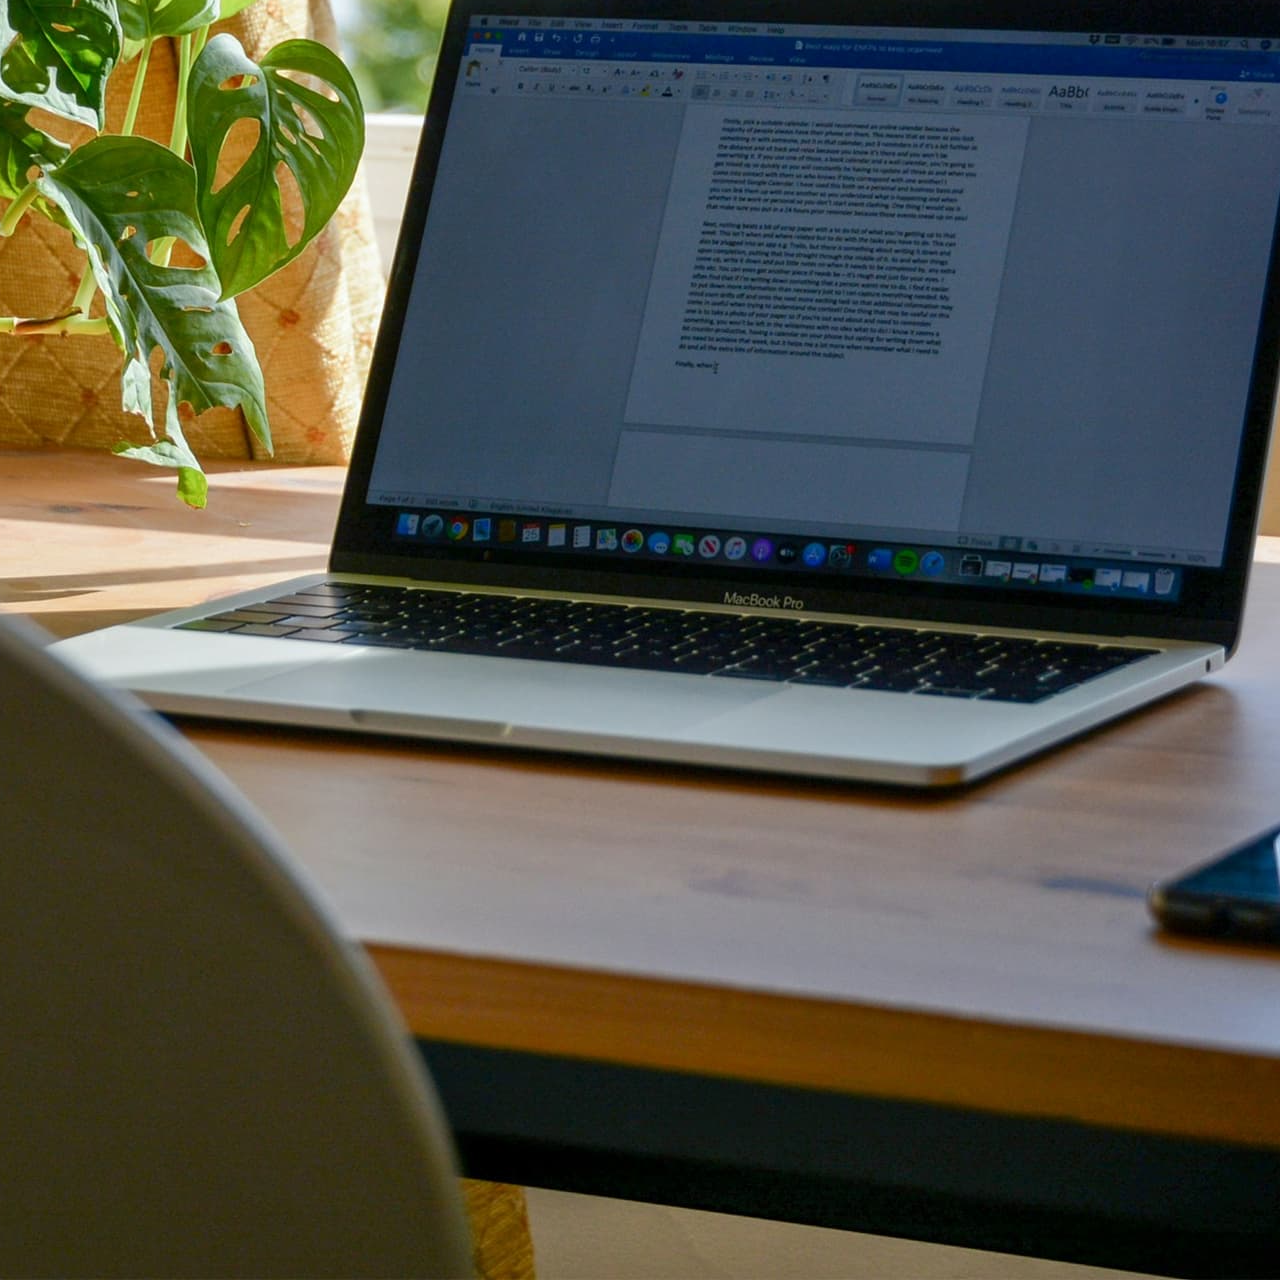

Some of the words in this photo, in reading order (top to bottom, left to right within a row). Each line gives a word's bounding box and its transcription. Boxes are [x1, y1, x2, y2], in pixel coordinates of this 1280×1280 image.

[524, 529, 538, 541] 25
[724, 592, 781, 608] MacBook
[783, 595, 804, 610] Pro
